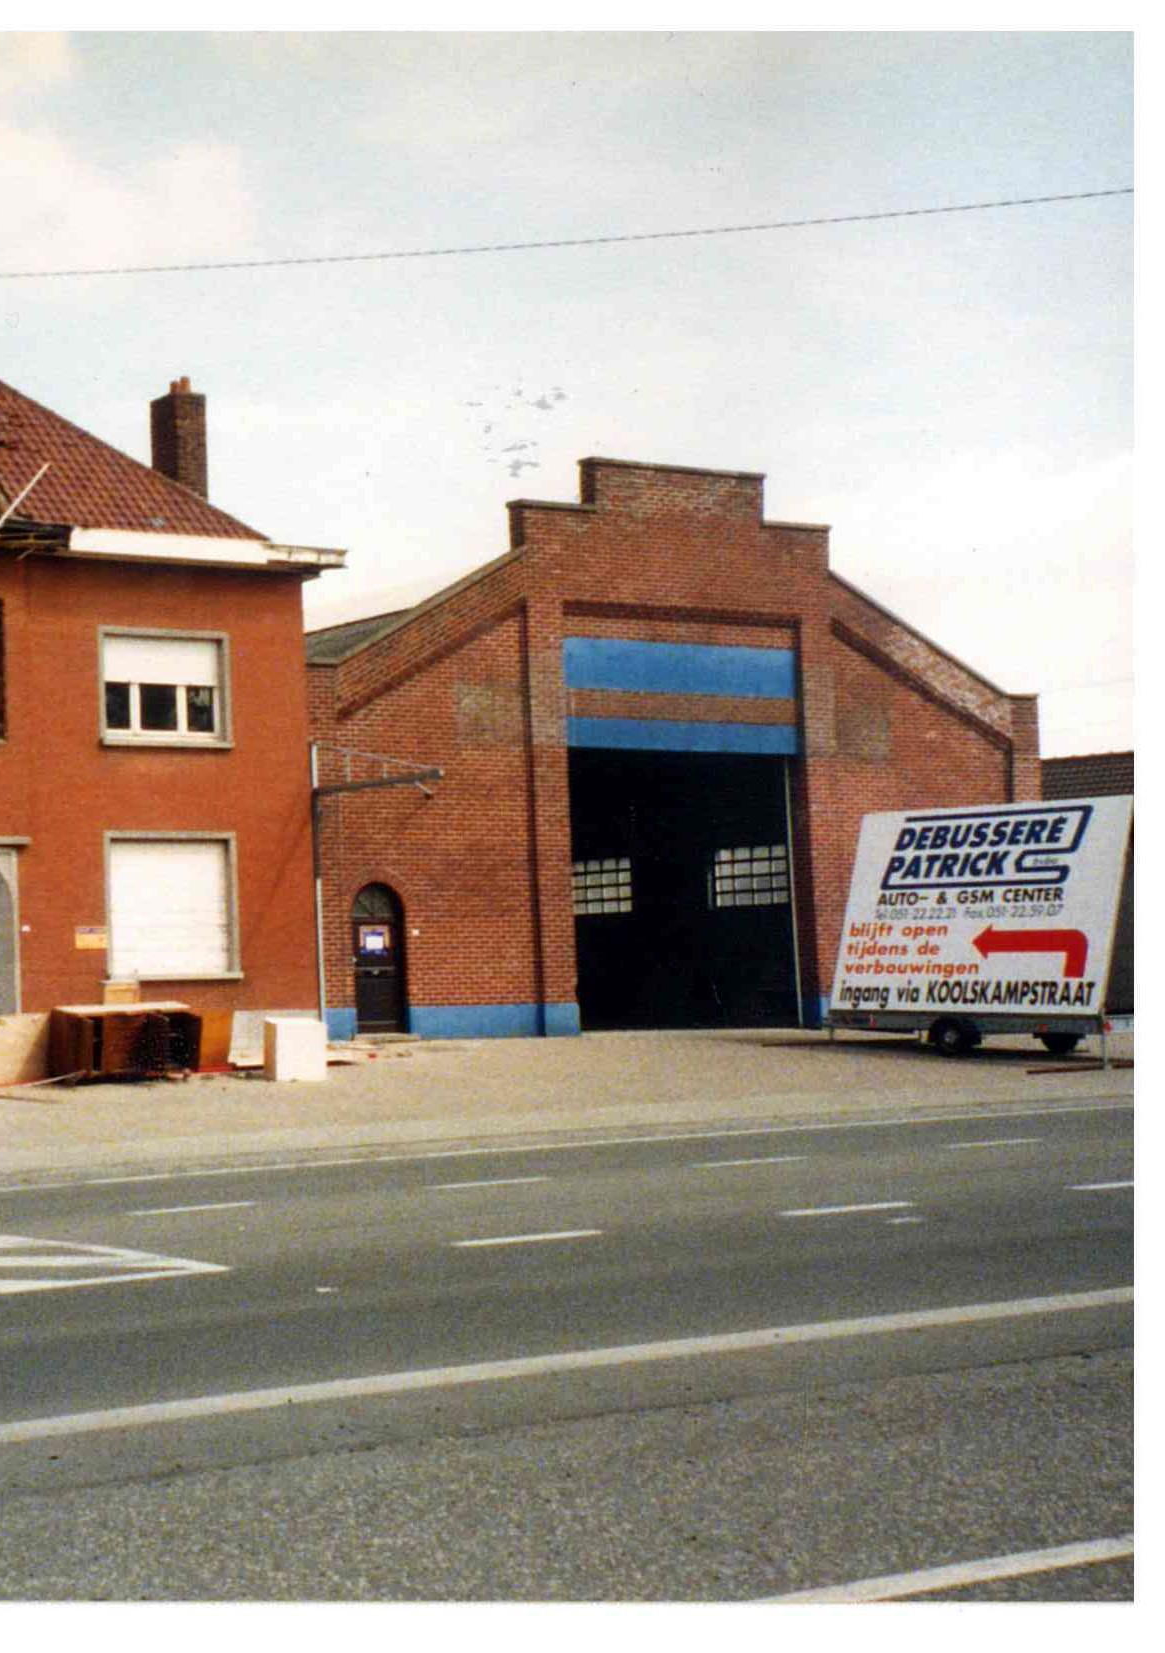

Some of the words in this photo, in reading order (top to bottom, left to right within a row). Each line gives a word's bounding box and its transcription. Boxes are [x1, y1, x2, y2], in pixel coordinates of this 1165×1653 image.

[894, 816, 1067, 851] DEBUSSERÉ
[884, 850, 1010, 881] PATRICK
[876, 892, 928, 907] AUTO-
[936, 891, 948, 905] &
[957, 889, 994, 905] GSM
[1002, 887, 1064, 903] CENTER
[849, 921, 893, 940] blijft
[900, 924, 949, 940] open
[846, 940, 908, 959] tijdens
[916, 940, 940, 956] de
[844, 959, 980, 978] verbouwingen
[839, 979, 891, 1009] ingang
[897, 979, 921, 1003] via
[925, 978, 1096, 1007] KOOLSKAMPSTRAAT
